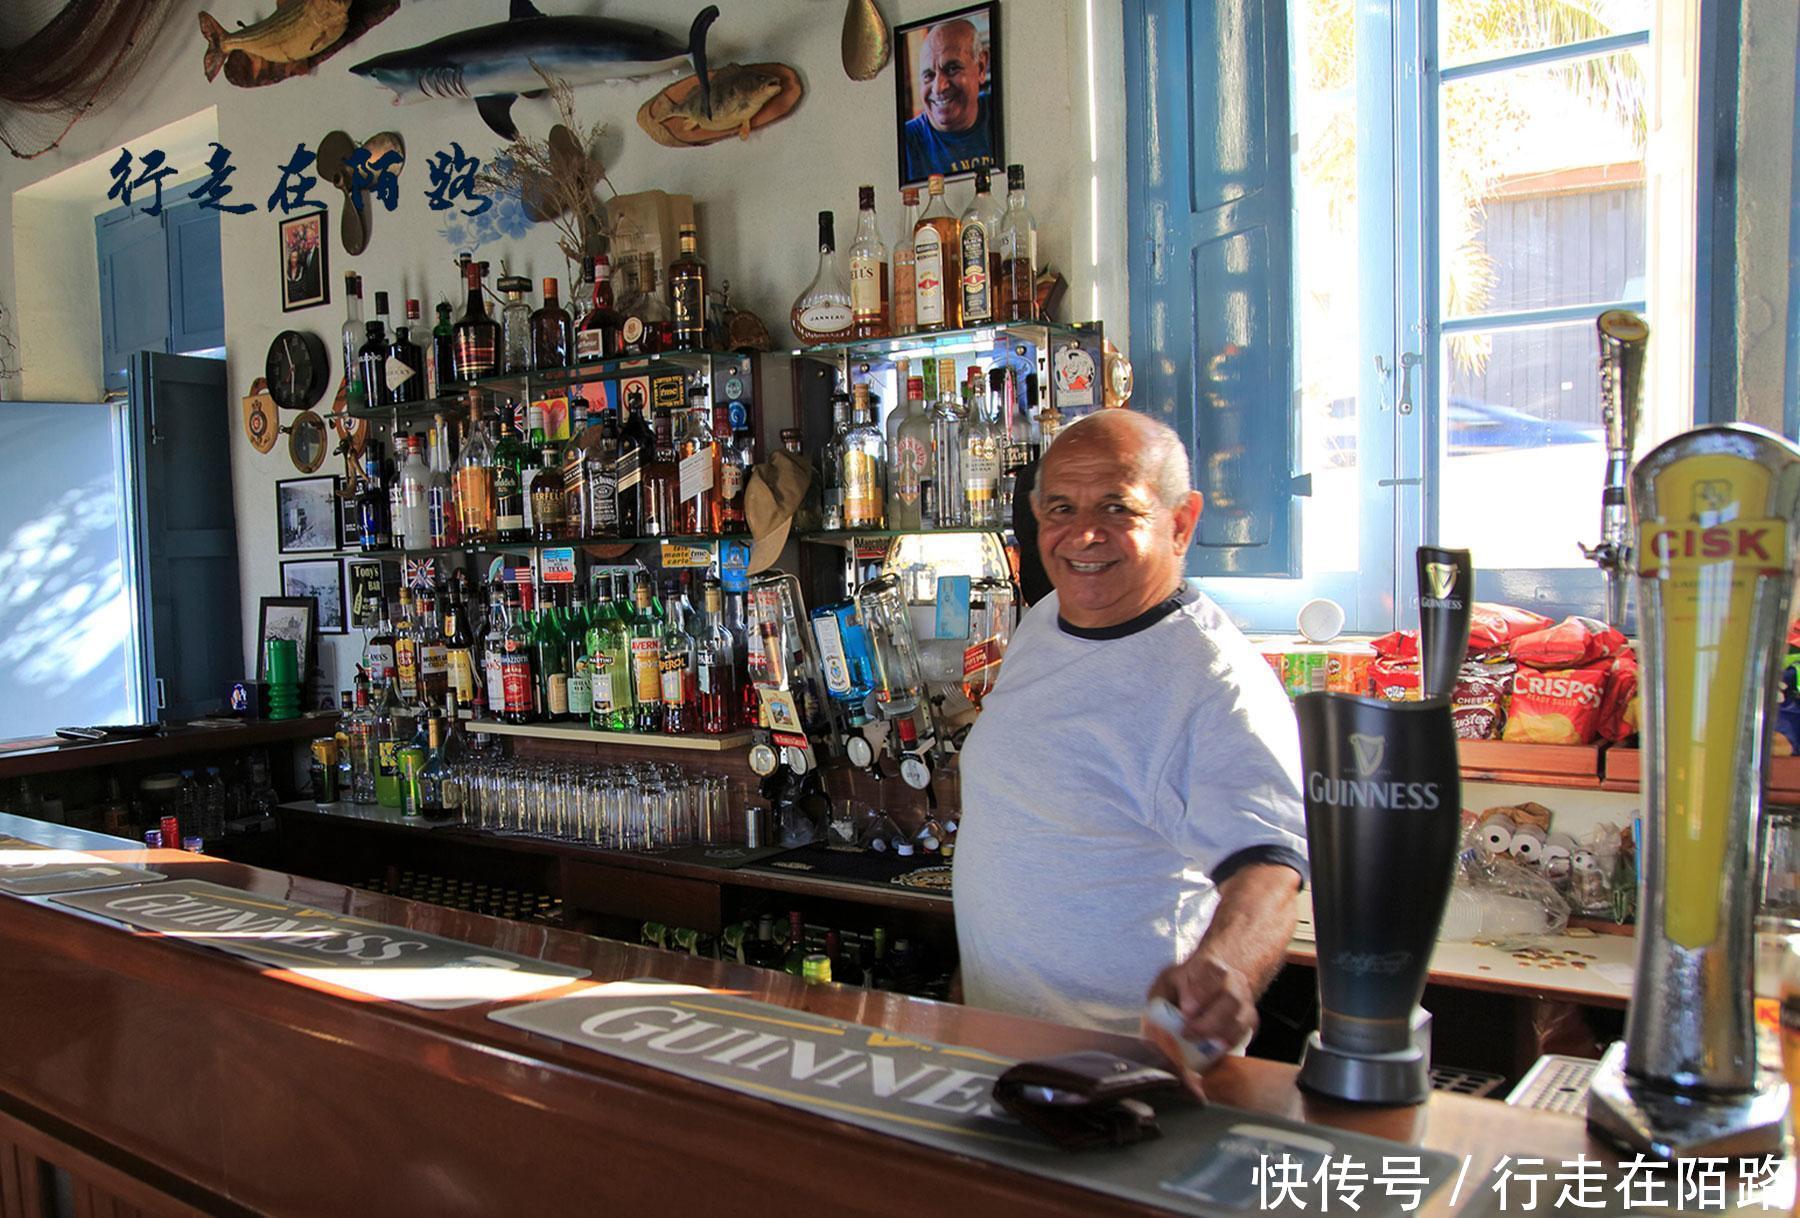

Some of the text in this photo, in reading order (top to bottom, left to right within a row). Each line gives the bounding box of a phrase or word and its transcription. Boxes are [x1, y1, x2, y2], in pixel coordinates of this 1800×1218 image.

[1650, 528, 1770, 561] CISK
[354, 565, 379, 579] Tony's
[368, 580, 381, 591] BAR
[1421, 596, 1463, 610] GUINNESS
[1513, 673, 1604, 708] CRISPS
[1308, 770, 1441, 811] GUINNESS
[104, 892, 430, 963] GUINNESS
[580, 1003, 996, 1114] GUINNE
